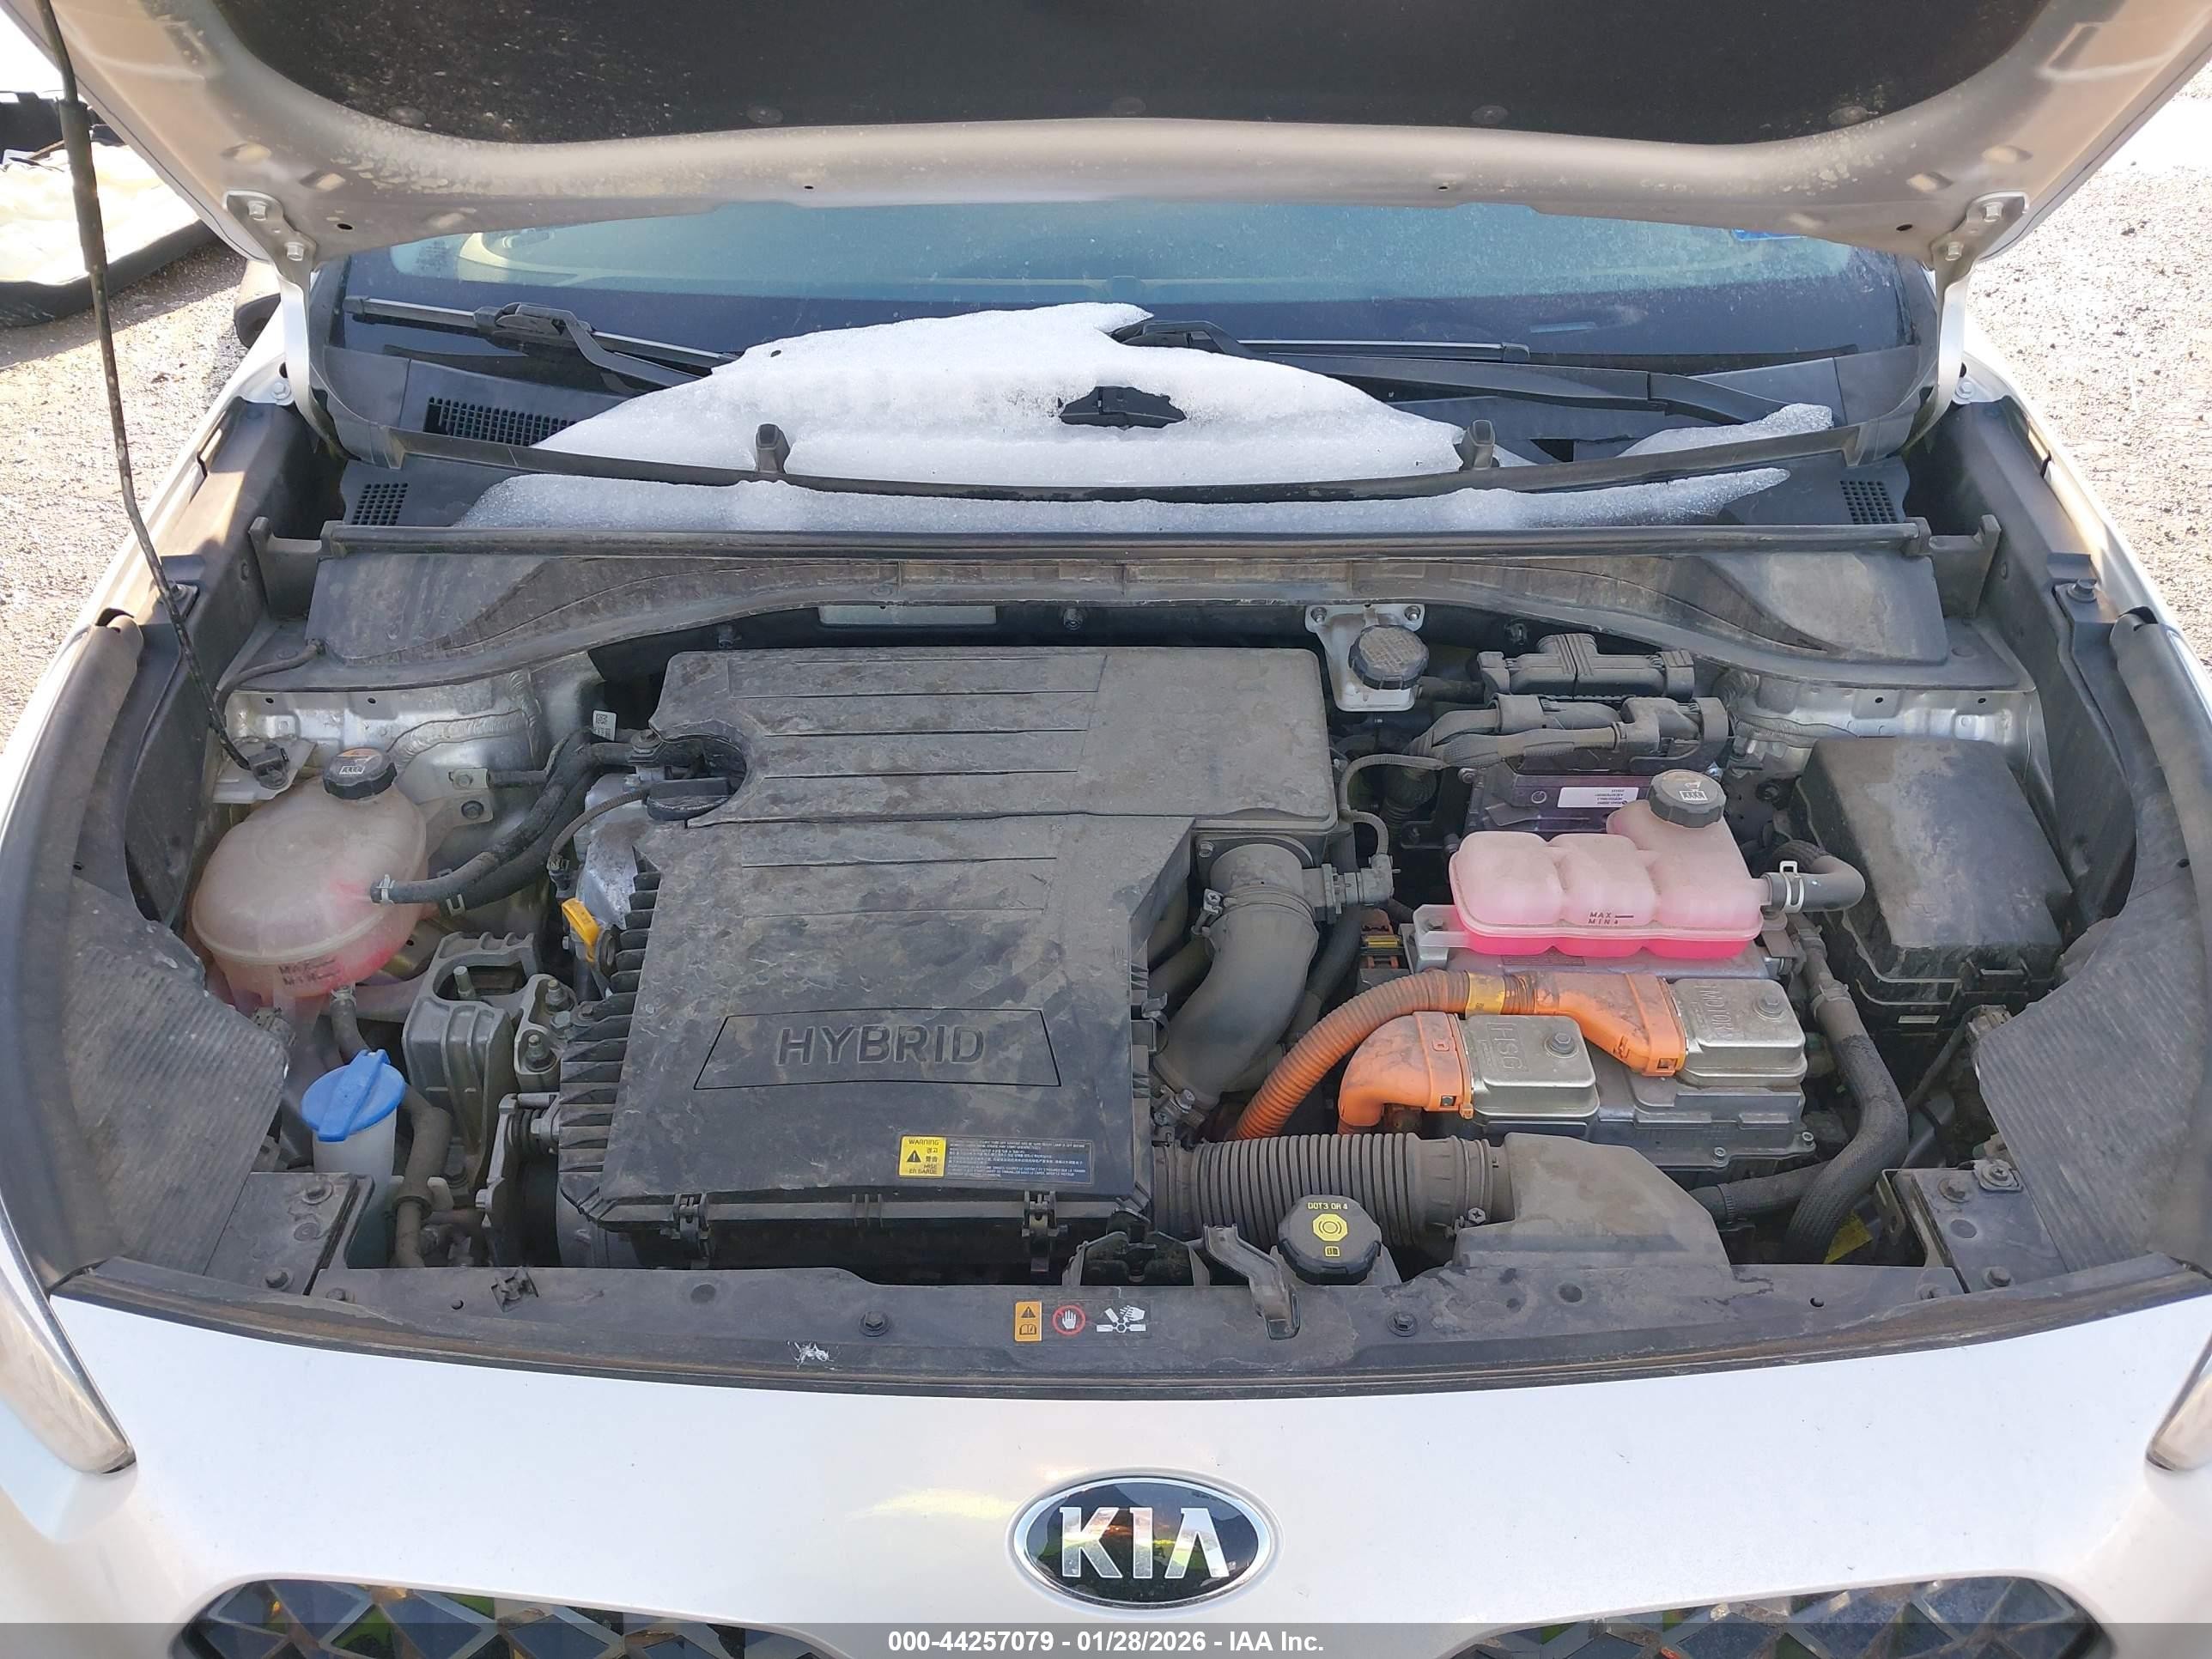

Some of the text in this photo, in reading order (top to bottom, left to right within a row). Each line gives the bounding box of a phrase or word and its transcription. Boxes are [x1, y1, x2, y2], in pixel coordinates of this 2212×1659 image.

[776, 1024, 985, 1066] HYBRID
[1490, 1027, 1524, 1070] HSG
[1060, 1507, 1230, 1579] KIA
